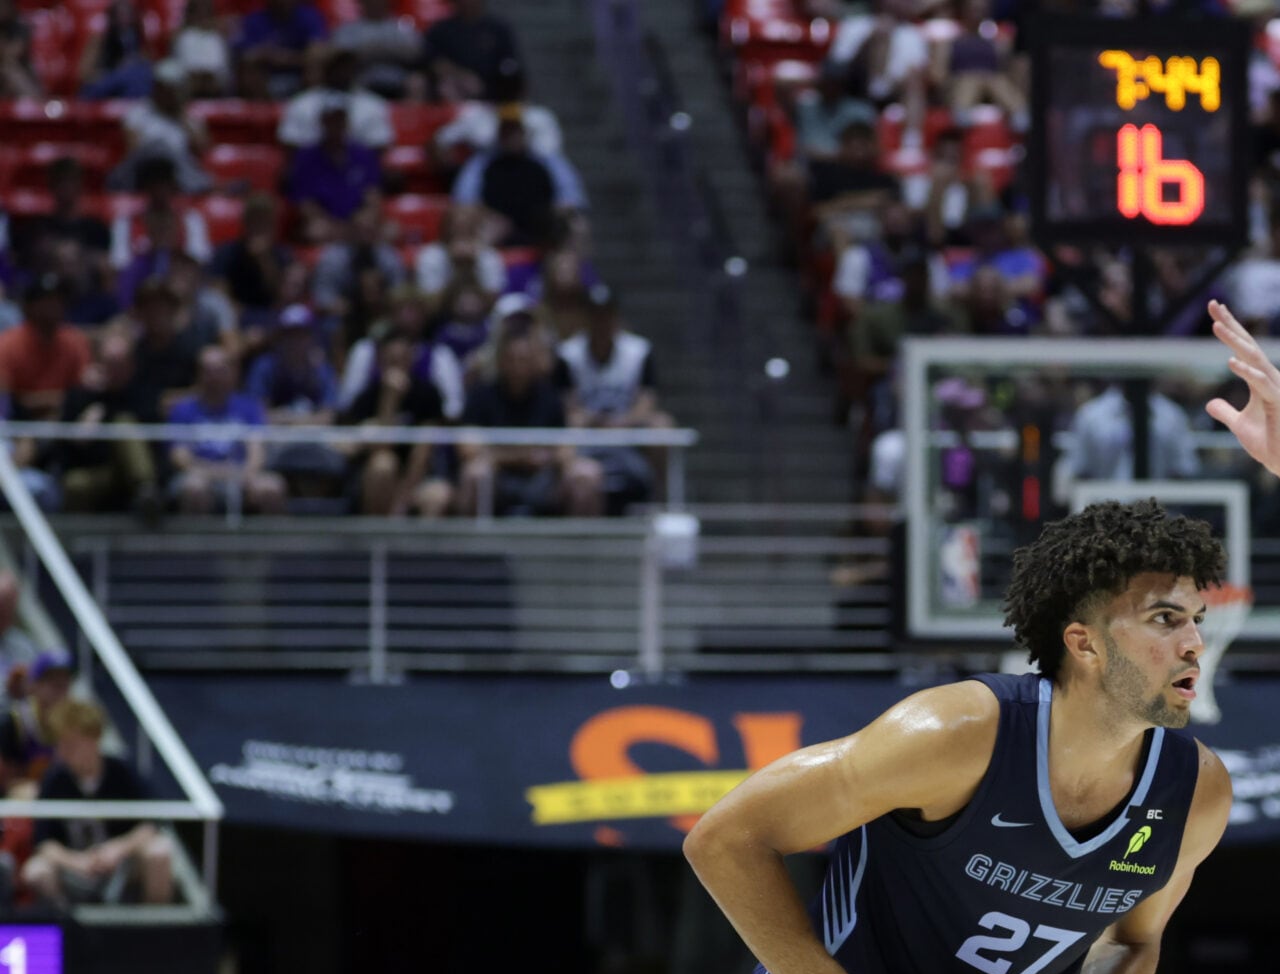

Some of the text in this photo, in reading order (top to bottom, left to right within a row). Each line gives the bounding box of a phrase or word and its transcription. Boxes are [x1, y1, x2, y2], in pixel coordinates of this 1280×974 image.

[1098, 50, 1221, 112] 7:44
[1117, 123, 1205, 226] 16
[965, 853, 1143, 914] GRIZZLIES
[1109, 860, 1156, 875] Robinhood
